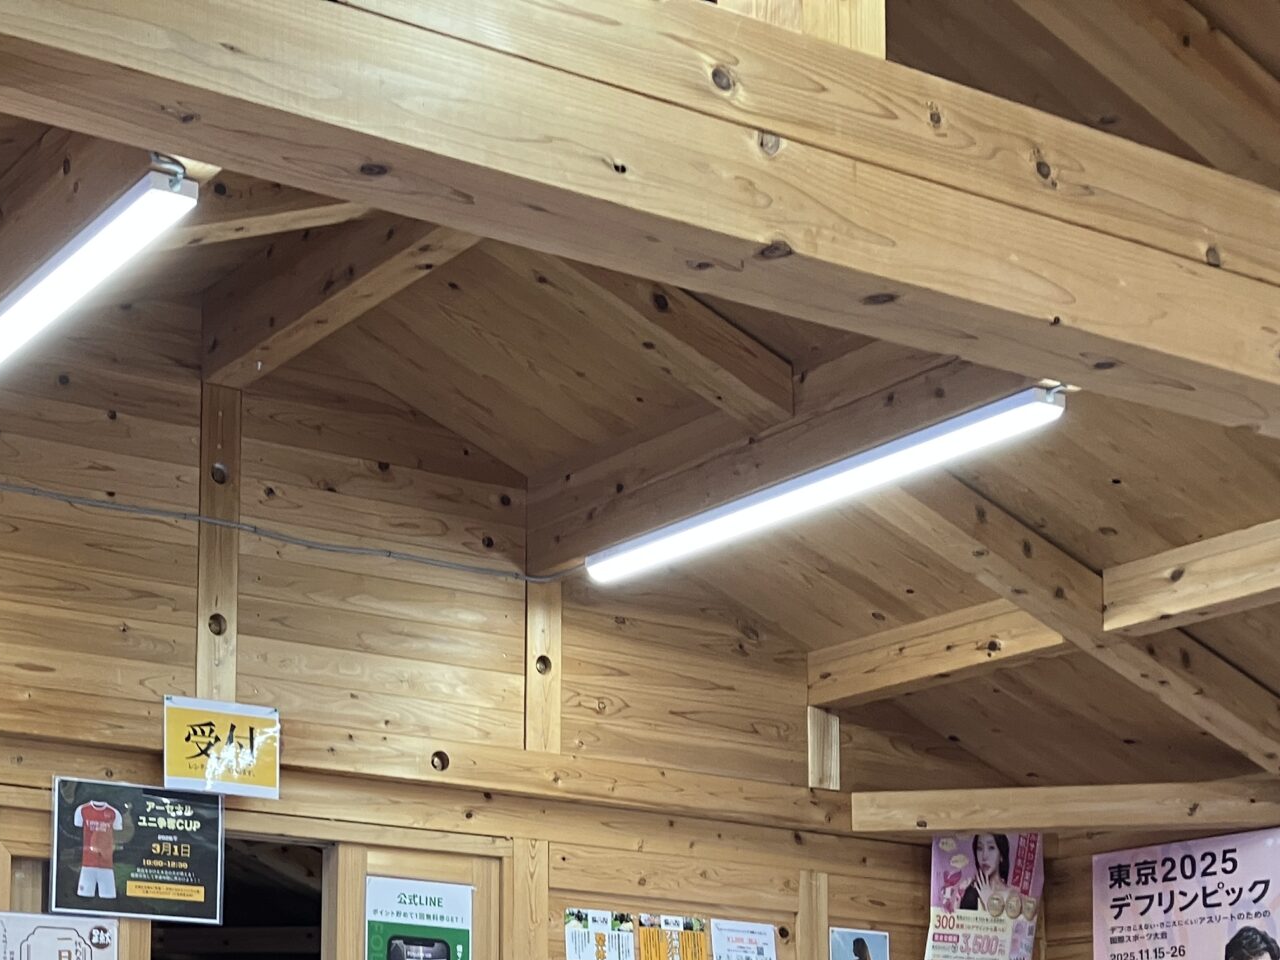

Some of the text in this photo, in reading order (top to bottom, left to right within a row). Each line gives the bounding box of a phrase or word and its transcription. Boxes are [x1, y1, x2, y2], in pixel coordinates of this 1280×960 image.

[185, 721, 256, 761] 受付
[1108, 848, 1238, 889] 東京2025
[397, 892, 444, 908] 公式LINE
[1110, 879, 1271, 920] デフリンピック
[934, 915, 955, 930] 300
